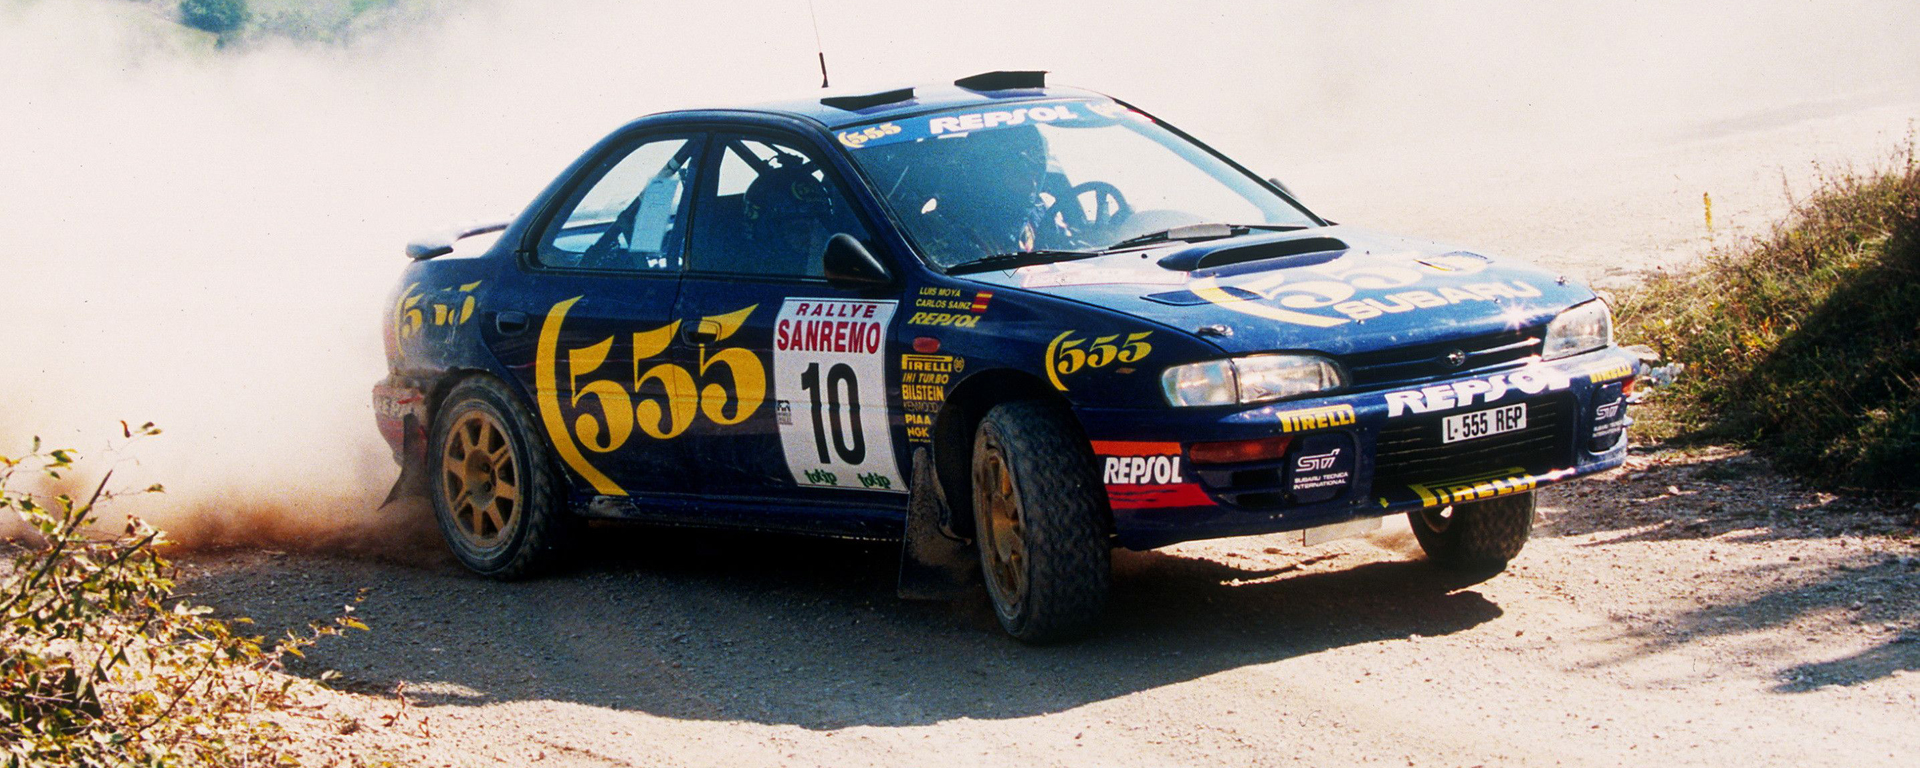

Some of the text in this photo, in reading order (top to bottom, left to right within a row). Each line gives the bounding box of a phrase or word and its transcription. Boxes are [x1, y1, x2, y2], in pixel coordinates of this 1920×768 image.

[929, 105, 1078, 135] REPSOL
[919, 287, 961, 297] LUIS MOYA
[1334, 279, 1543, 320] SUBARU
[796, 302, 877, 318] RALLYE
[915, 298, 971, 310] CARLOS SAINZ
[907, 311, 981, 328] REPSOL
[777, 319, 881, 355] SANREMO
[901, 353, 954, 373] PIRELLI
[918, 374, 949, 385] TURBO
[902, 384, 945, 402] BILSTEIN
[1384, 369, 1571, 418] REPSOL
[801, 362, 866, 466] 10
[905, 413, 932, 426] PIAA
[1275, 403, 1356, 433] PIRELLI
[1496, 406, 1523, 432] REP
[907, 426, 930, 438] NGK
[1103, 456, 1183, 485] REPSOL
[1294, 475, 1321, 484] SUBARU
[1293, 478, 1346, 490] INTERNATIONAL
[1408, 466, 1537, 507] PIRELLI
